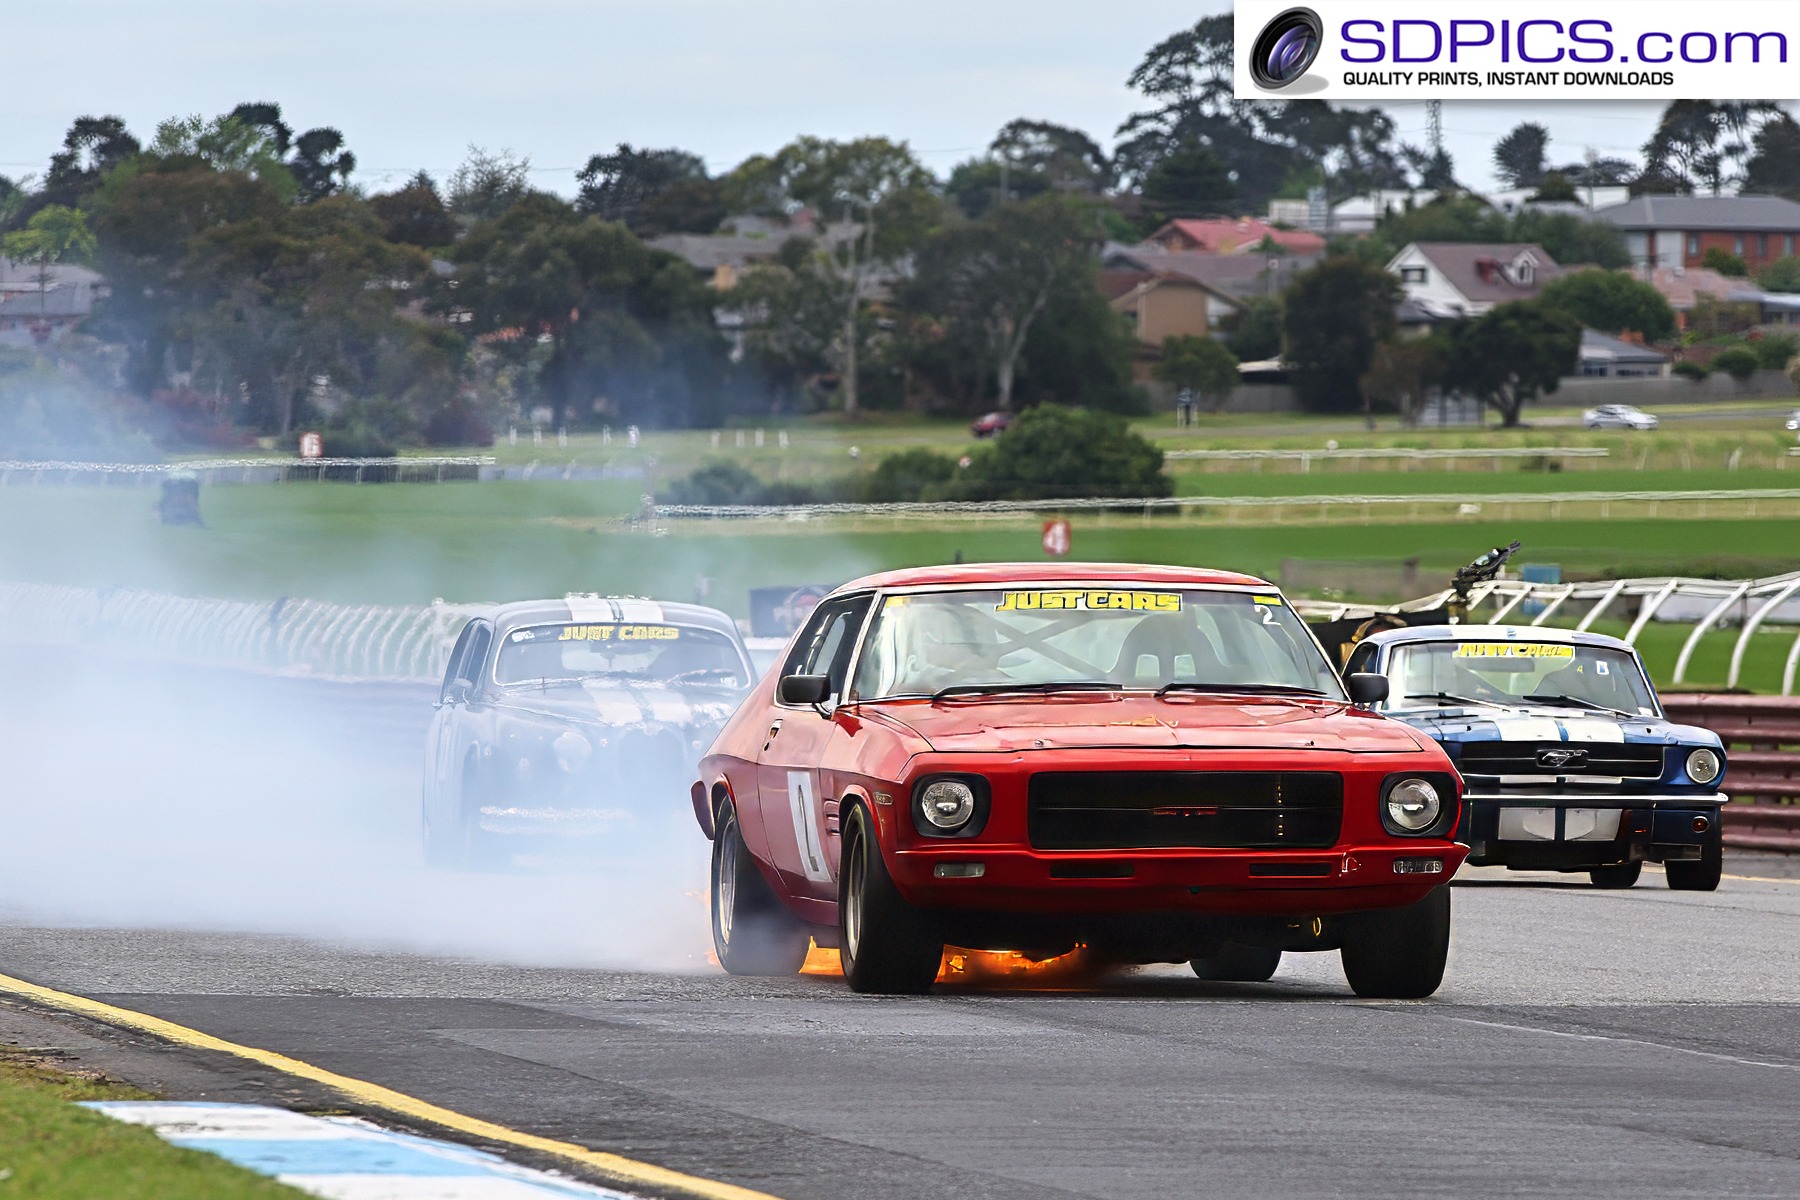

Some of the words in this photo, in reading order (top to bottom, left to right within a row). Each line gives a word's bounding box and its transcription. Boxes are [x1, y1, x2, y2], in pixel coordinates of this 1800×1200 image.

[995, 591, 1084, 612] JUST
[1085, 591, 1181, 612] CARS
[1253, 604, 1281, 625] 2
